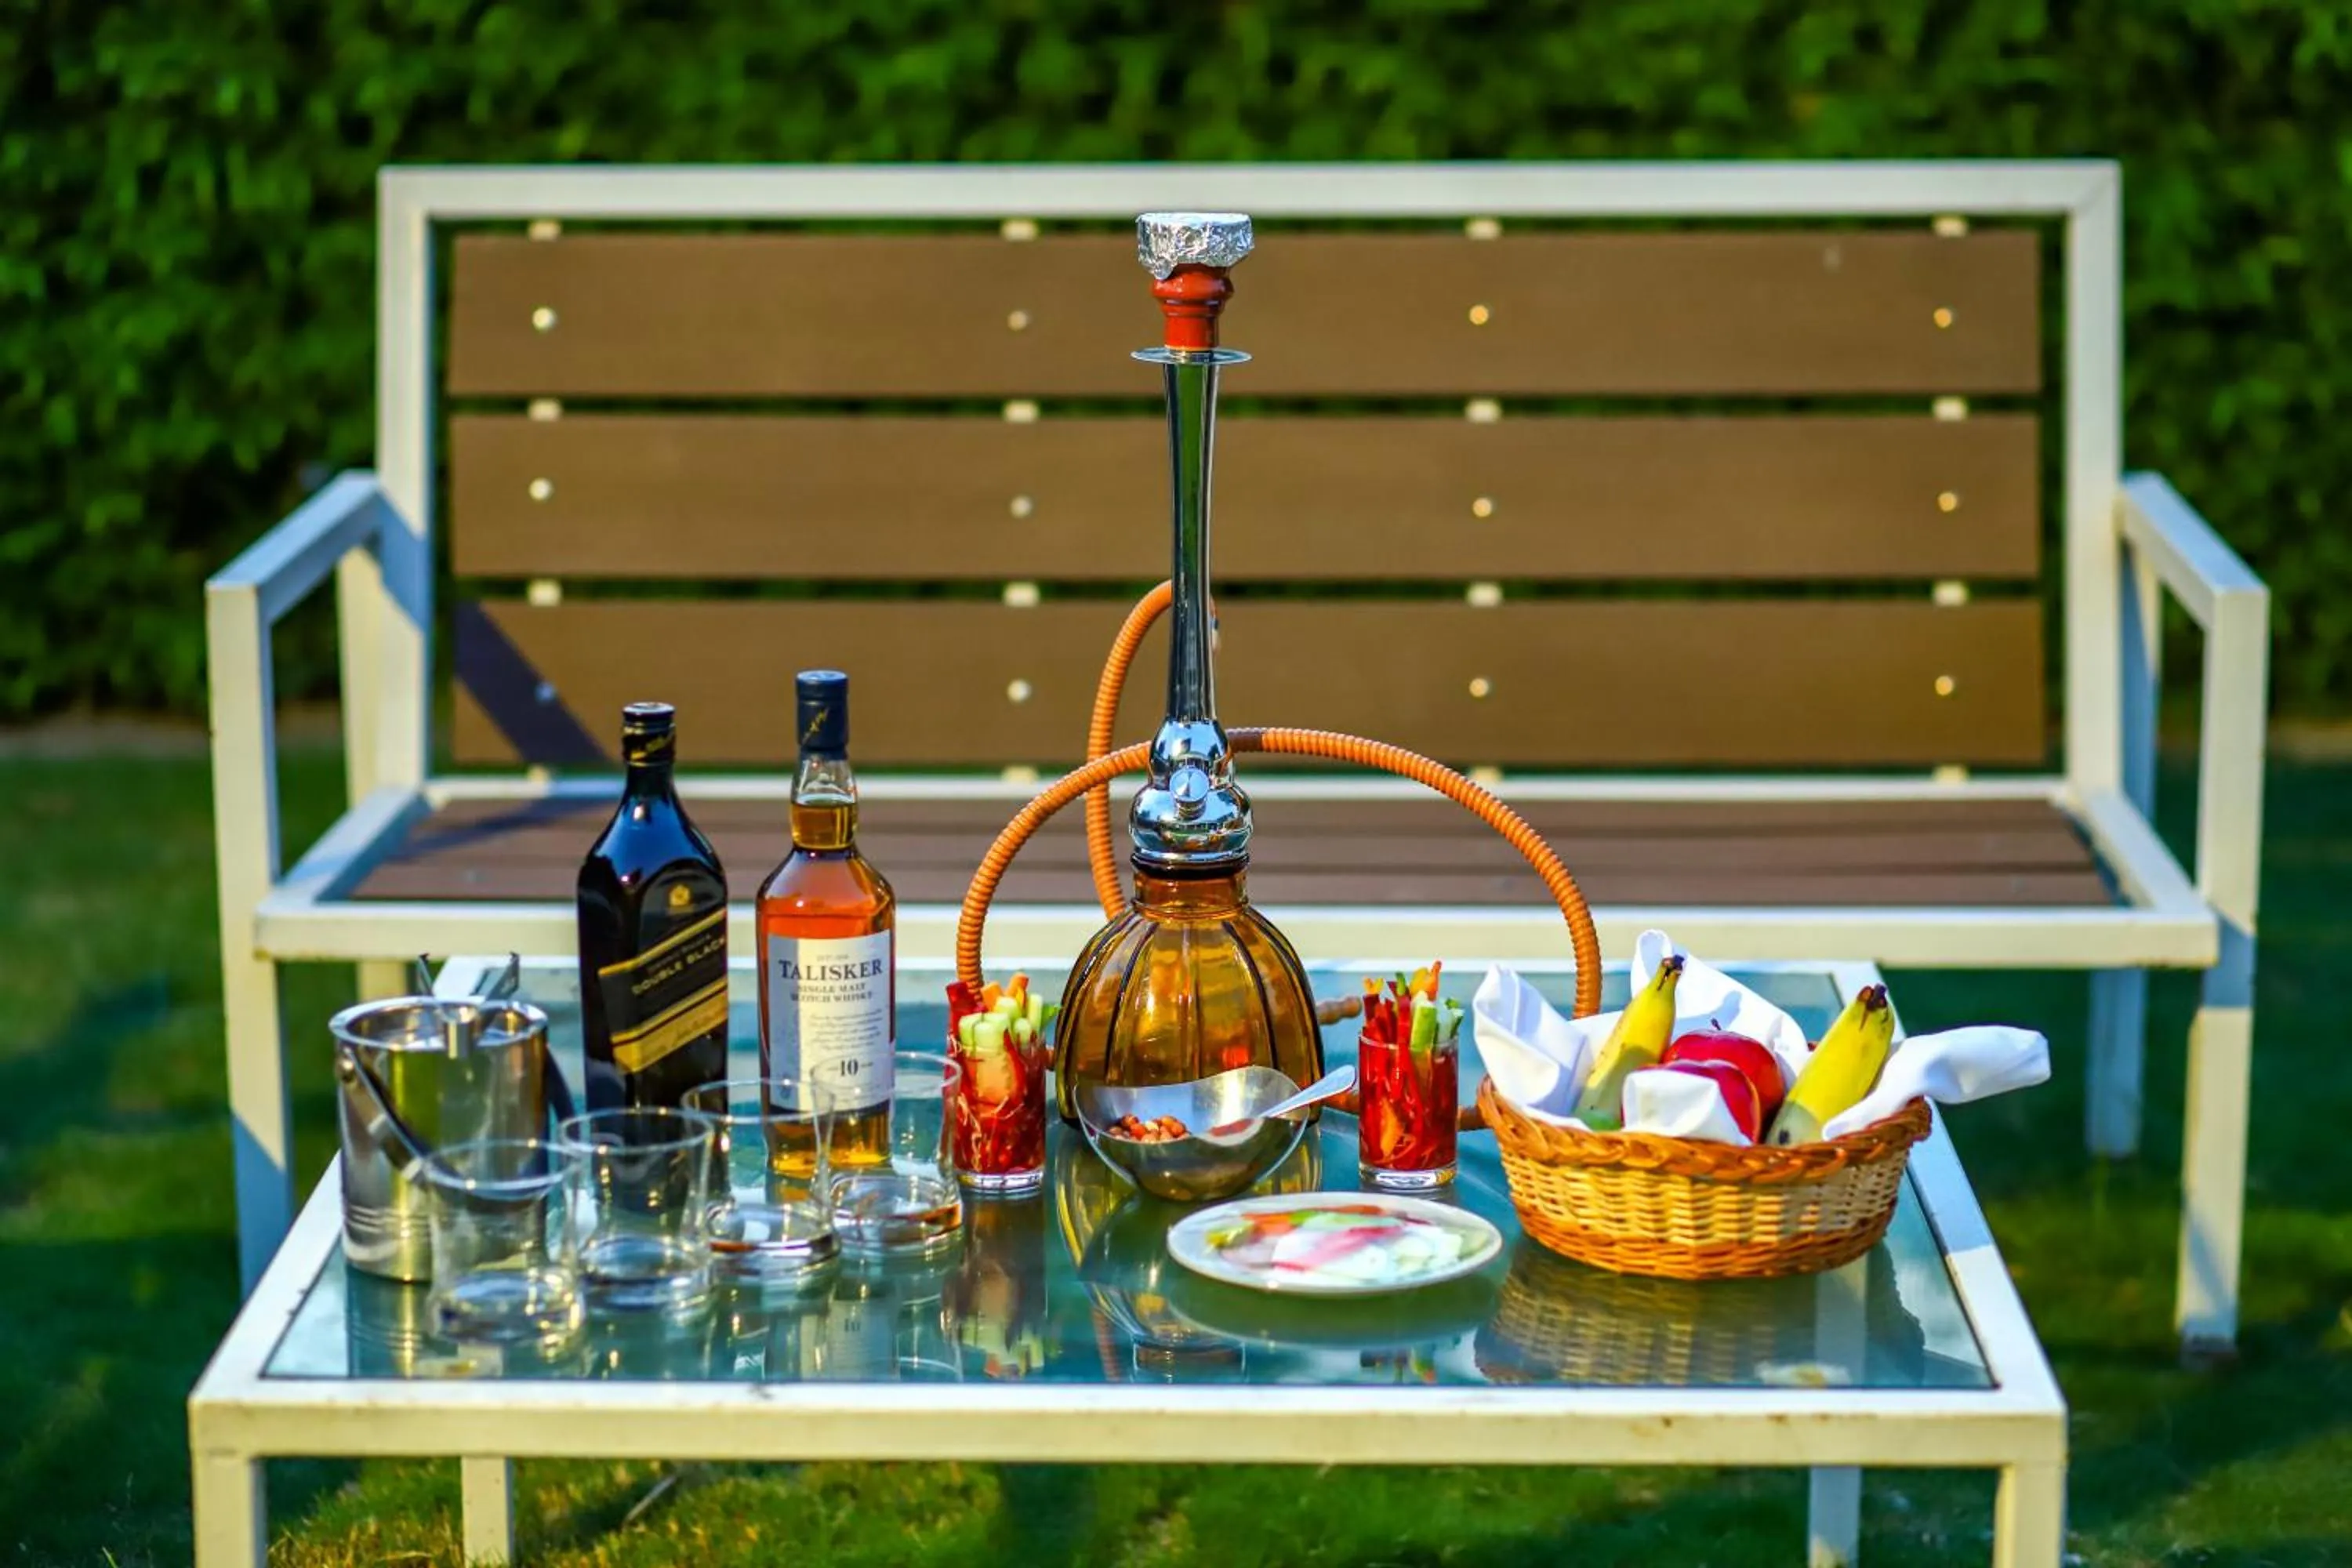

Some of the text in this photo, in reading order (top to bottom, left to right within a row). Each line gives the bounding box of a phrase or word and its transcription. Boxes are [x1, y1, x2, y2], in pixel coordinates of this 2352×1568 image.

[778, 958, 883, 981] TALISKER
[797, 982, 866, 994] SINGLE MALT
[840, 1059, 859, 1077] 10
